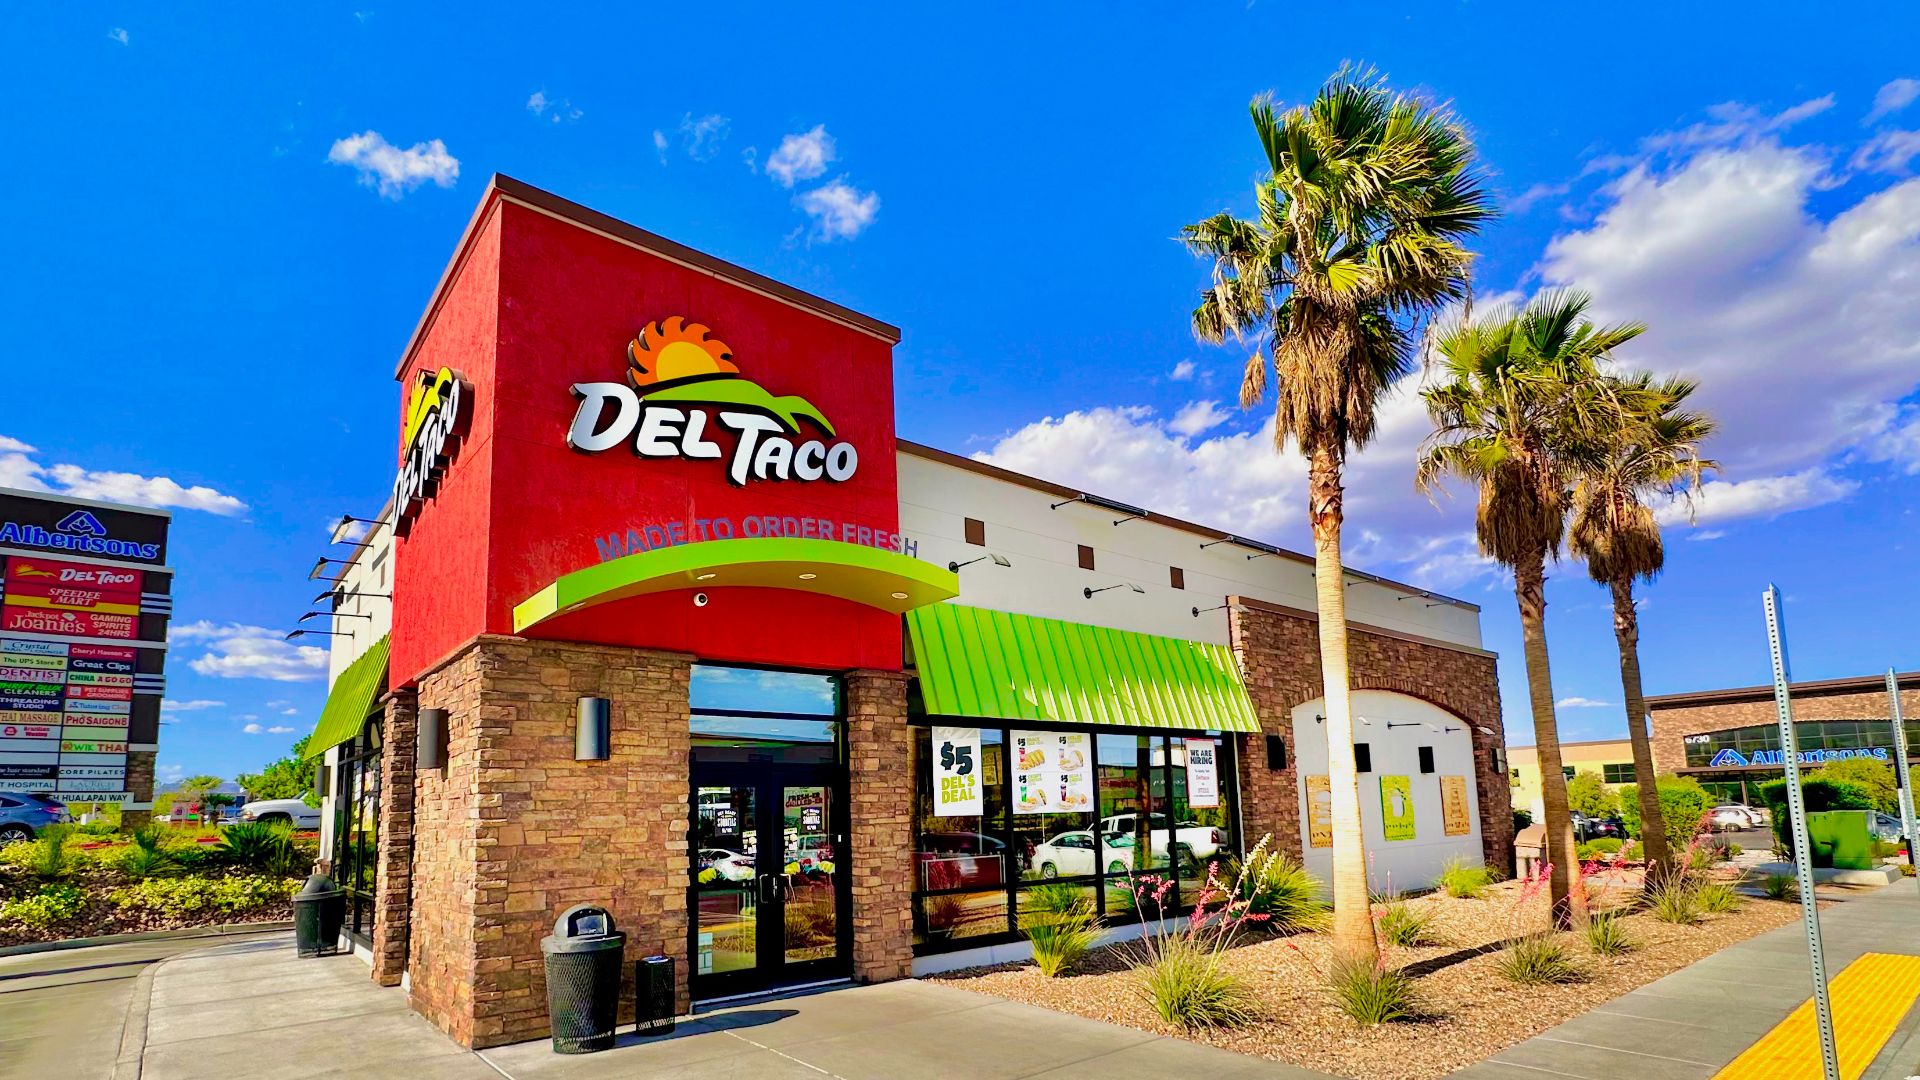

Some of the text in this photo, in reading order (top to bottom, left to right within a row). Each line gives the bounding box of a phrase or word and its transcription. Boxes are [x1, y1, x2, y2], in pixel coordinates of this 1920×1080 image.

[567, 382, 859, 486] DEL TACO
[391, 379, 461, 536] DEL TACO
[0, 522, 160, 559] Albertsons
[595, 516, 918, 562] MADE TO ORDER FRESH
[60, 569, 135, 585] DEL TACO
[48, 588, 102, 600] SPEEDEE
[56, 597, 93, 606] MART
[25, 611, 60, 621] Jackpot
[90, 614, 132, 624] GAMING
[10, 615, 86, 634] Joanie's
[92, 622, 132, 631] SPIRITS
[98, 629, 131, 638] 24HRS
[73, 660, 131, 671] Great Clips
[0, 668, 63, 679] DENTIST
[69, 674, 95, 682] CHINA
[4, 688, 57, 697] CLEANERS
[0, 697, 60, 705] THREADING
[19, 713, 60, 723] MASSAGE
[1190, 749, 1213, 757] WE ARE
[941, 741, 973, 776] $5
[1190, 756, 1213, 765] HIRING
[8, 781, 54, 789] HOSPITAL
[941, 774, 976, 791] DEL'S
[62, 794, 107, 802] HUALAPAI
[109, 794, 128, 802] WAY
[941, 787, 976, 804] DEAL
